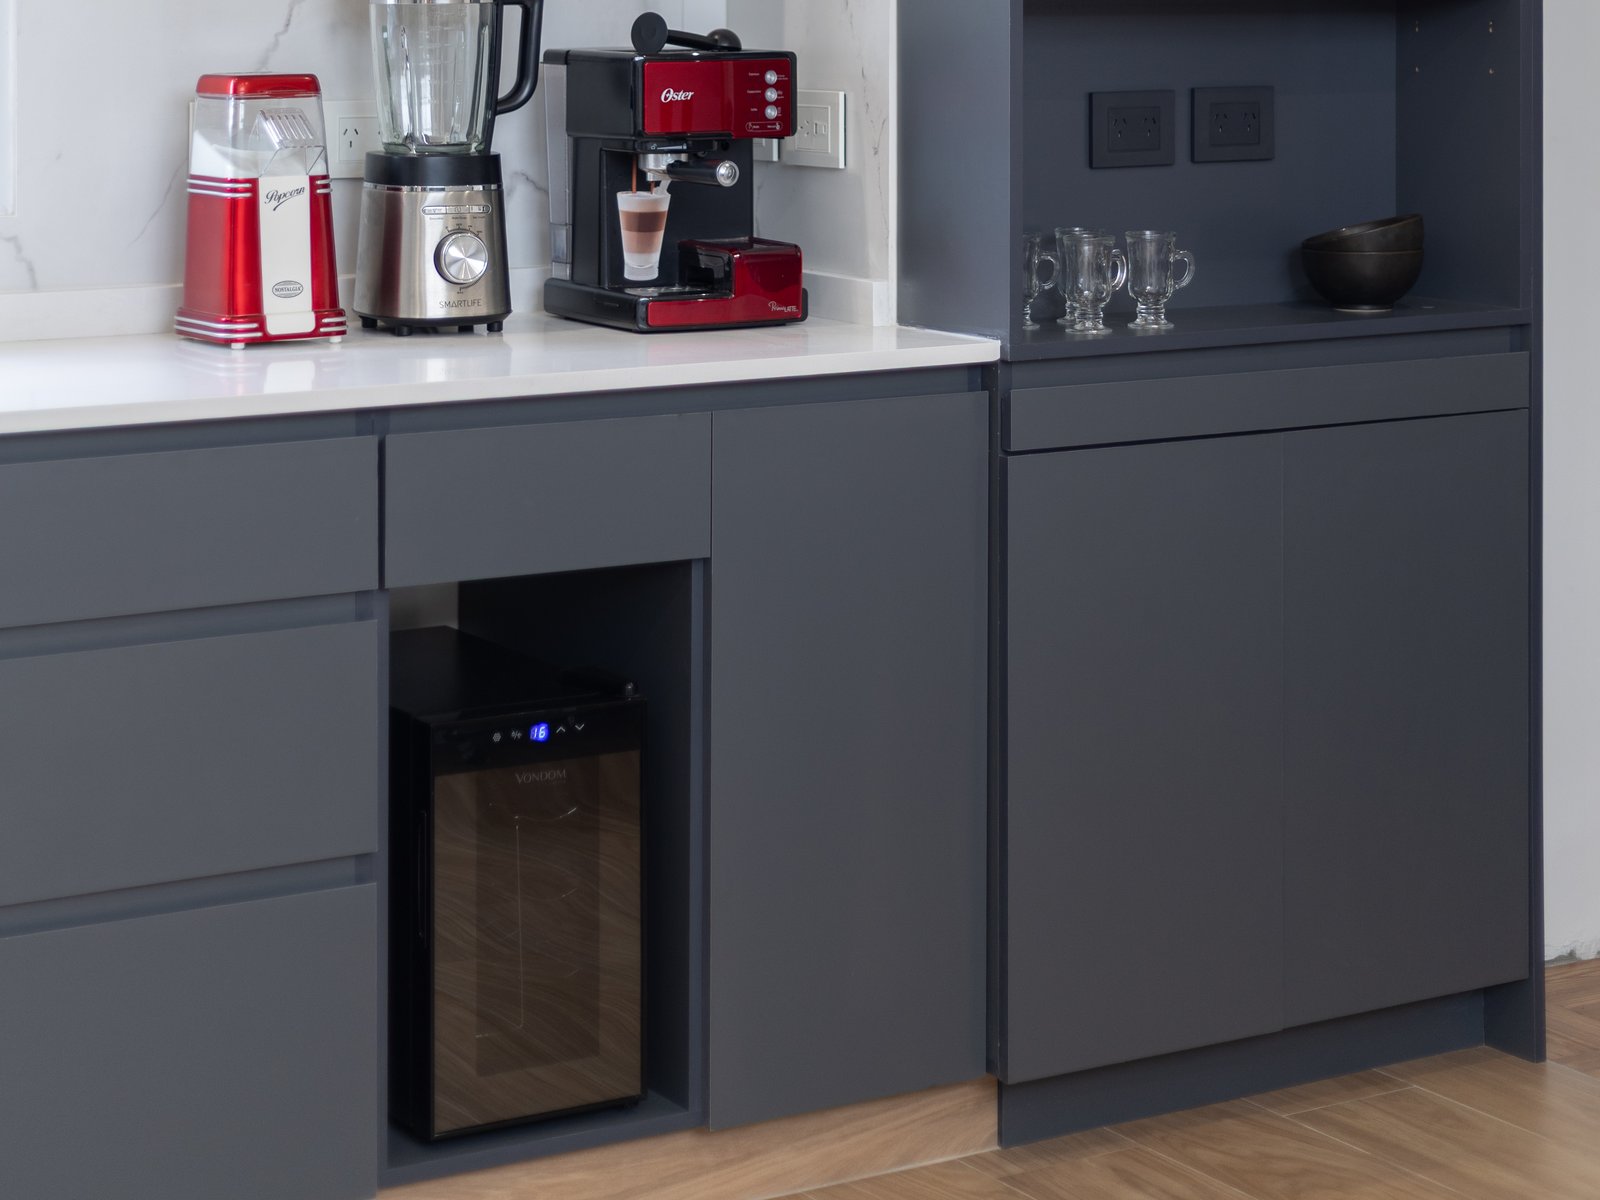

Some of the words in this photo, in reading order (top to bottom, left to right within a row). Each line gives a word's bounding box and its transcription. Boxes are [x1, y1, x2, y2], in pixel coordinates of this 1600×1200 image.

[661, 88, 695, 103] Oster
[264, 186, 304, 208] Popcorn
[439, 298, 482, 308] SMARTLIFE
[533, 726, 546, 739] 16
[514, 770, 566, 784] VONDOM
